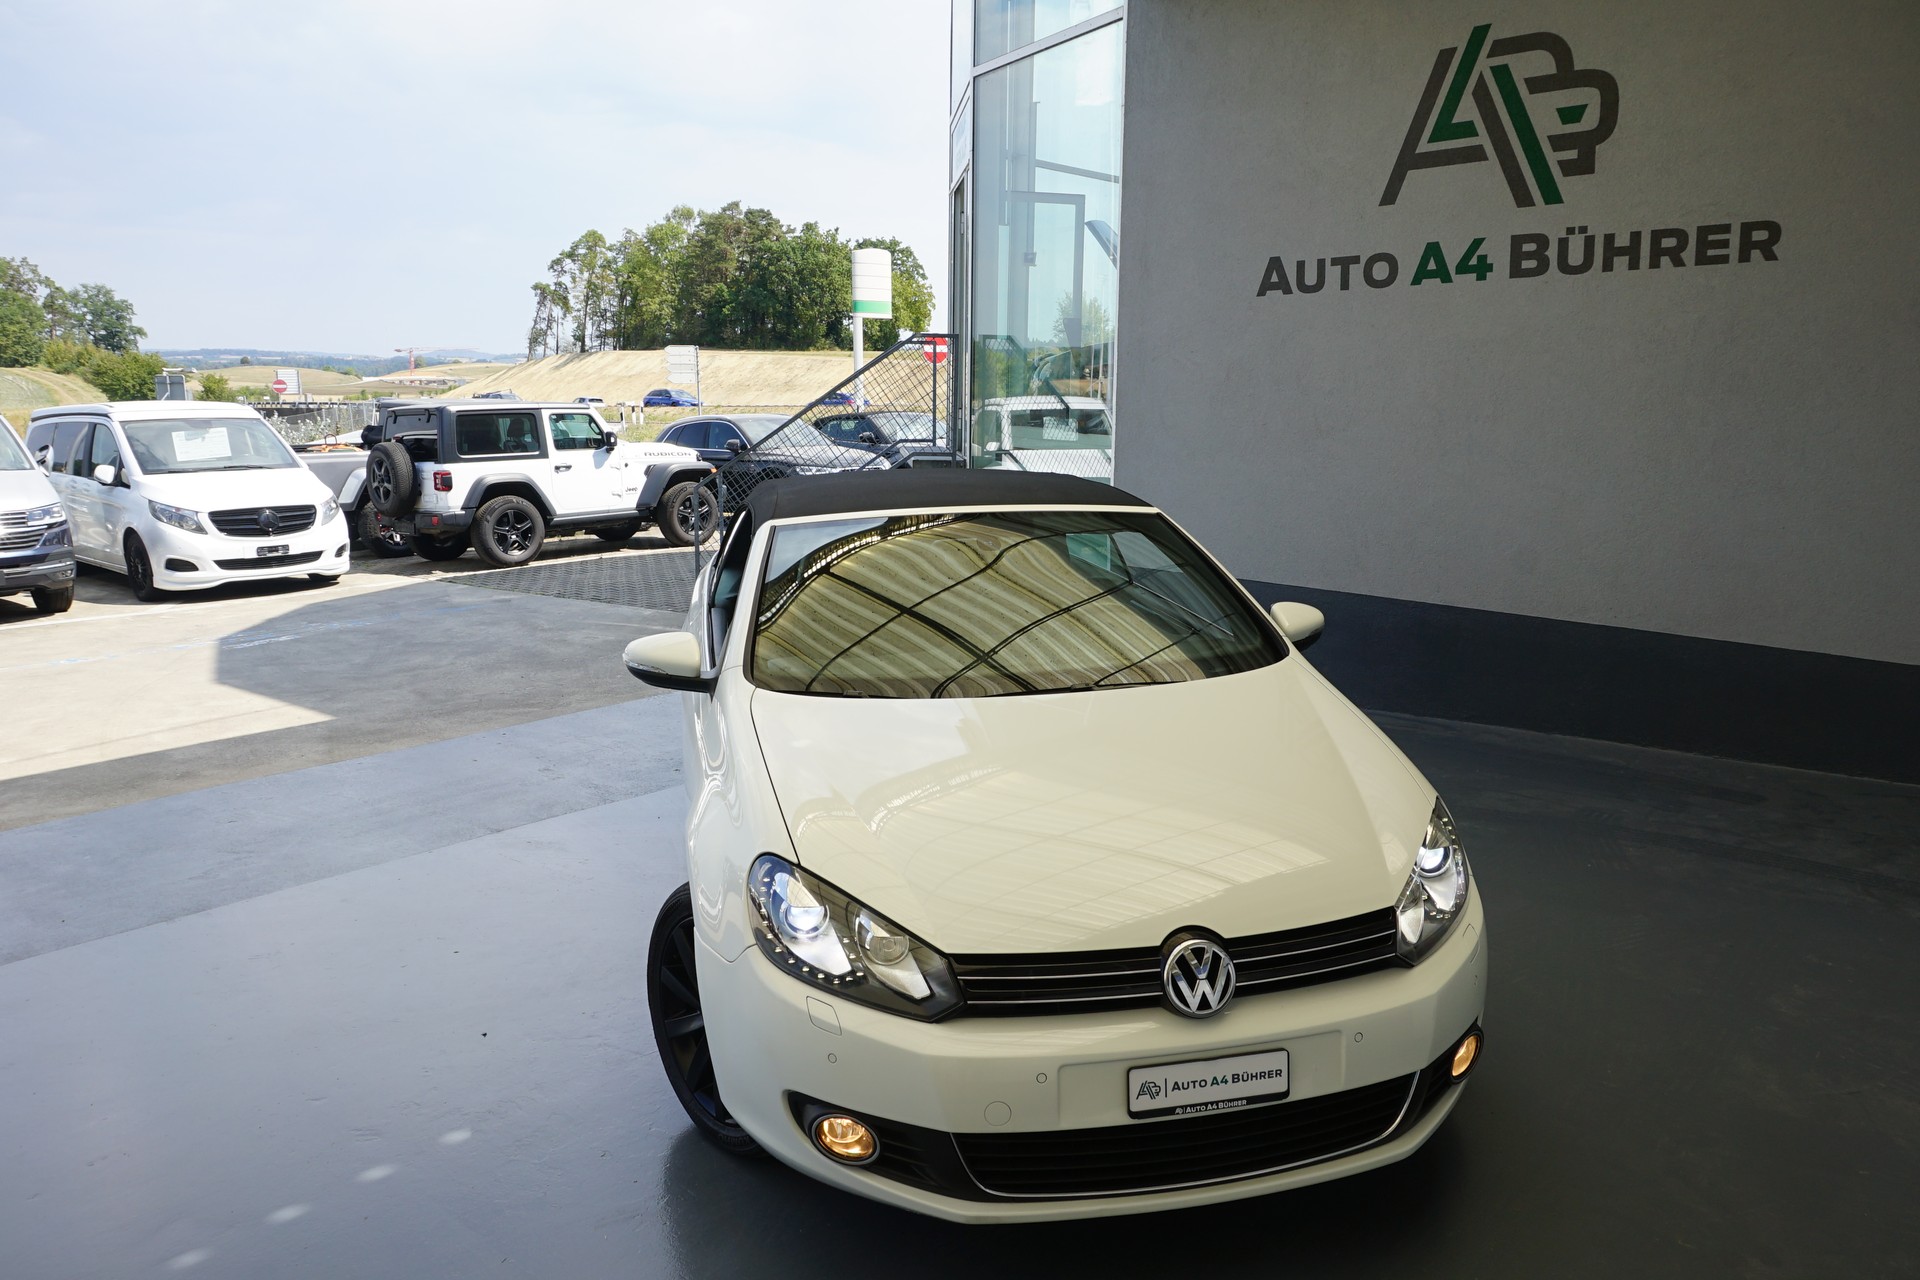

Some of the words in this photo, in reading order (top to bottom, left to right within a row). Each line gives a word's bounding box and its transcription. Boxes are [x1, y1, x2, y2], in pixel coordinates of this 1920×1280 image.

[1256, 252, 1399, 297] AUTO
[1410, 237, 1494, 286] A4
[1508, 220, 1782, 279] BÜHRER
[1171, 1079, 1207, 1092] AUTO
[1210, 1075, 1229, 1087] A4
[1231, 1069, 1283, 1084] BÜHRER
[1186, 1105, 1206, 1113] AUTO
[1218, 1100, 1247, 1109] BÜHRER
